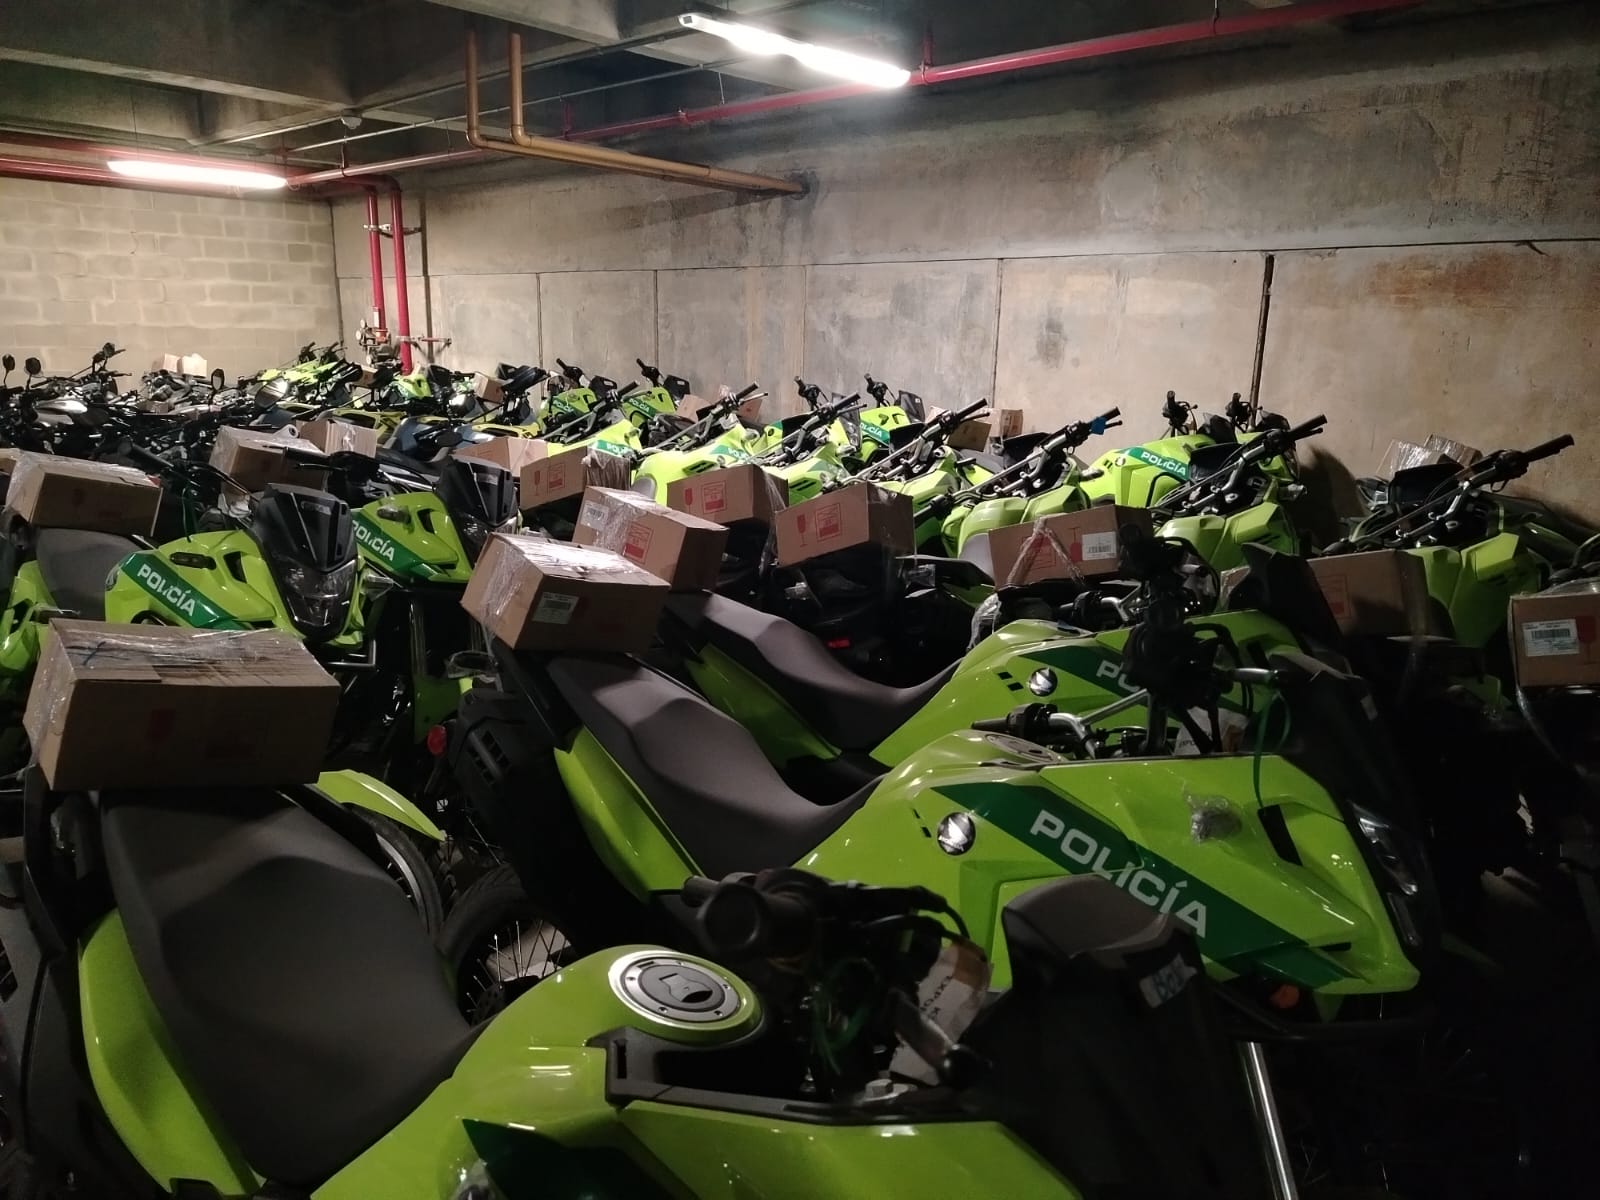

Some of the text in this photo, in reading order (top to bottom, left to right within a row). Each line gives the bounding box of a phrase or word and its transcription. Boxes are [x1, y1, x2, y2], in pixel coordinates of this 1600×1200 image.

[1140, 451, 1187, 476] POLICÍA
[136, 563, 196, 617] POLICÍA
[1029, 808, 1207, 939] POLICÍA
